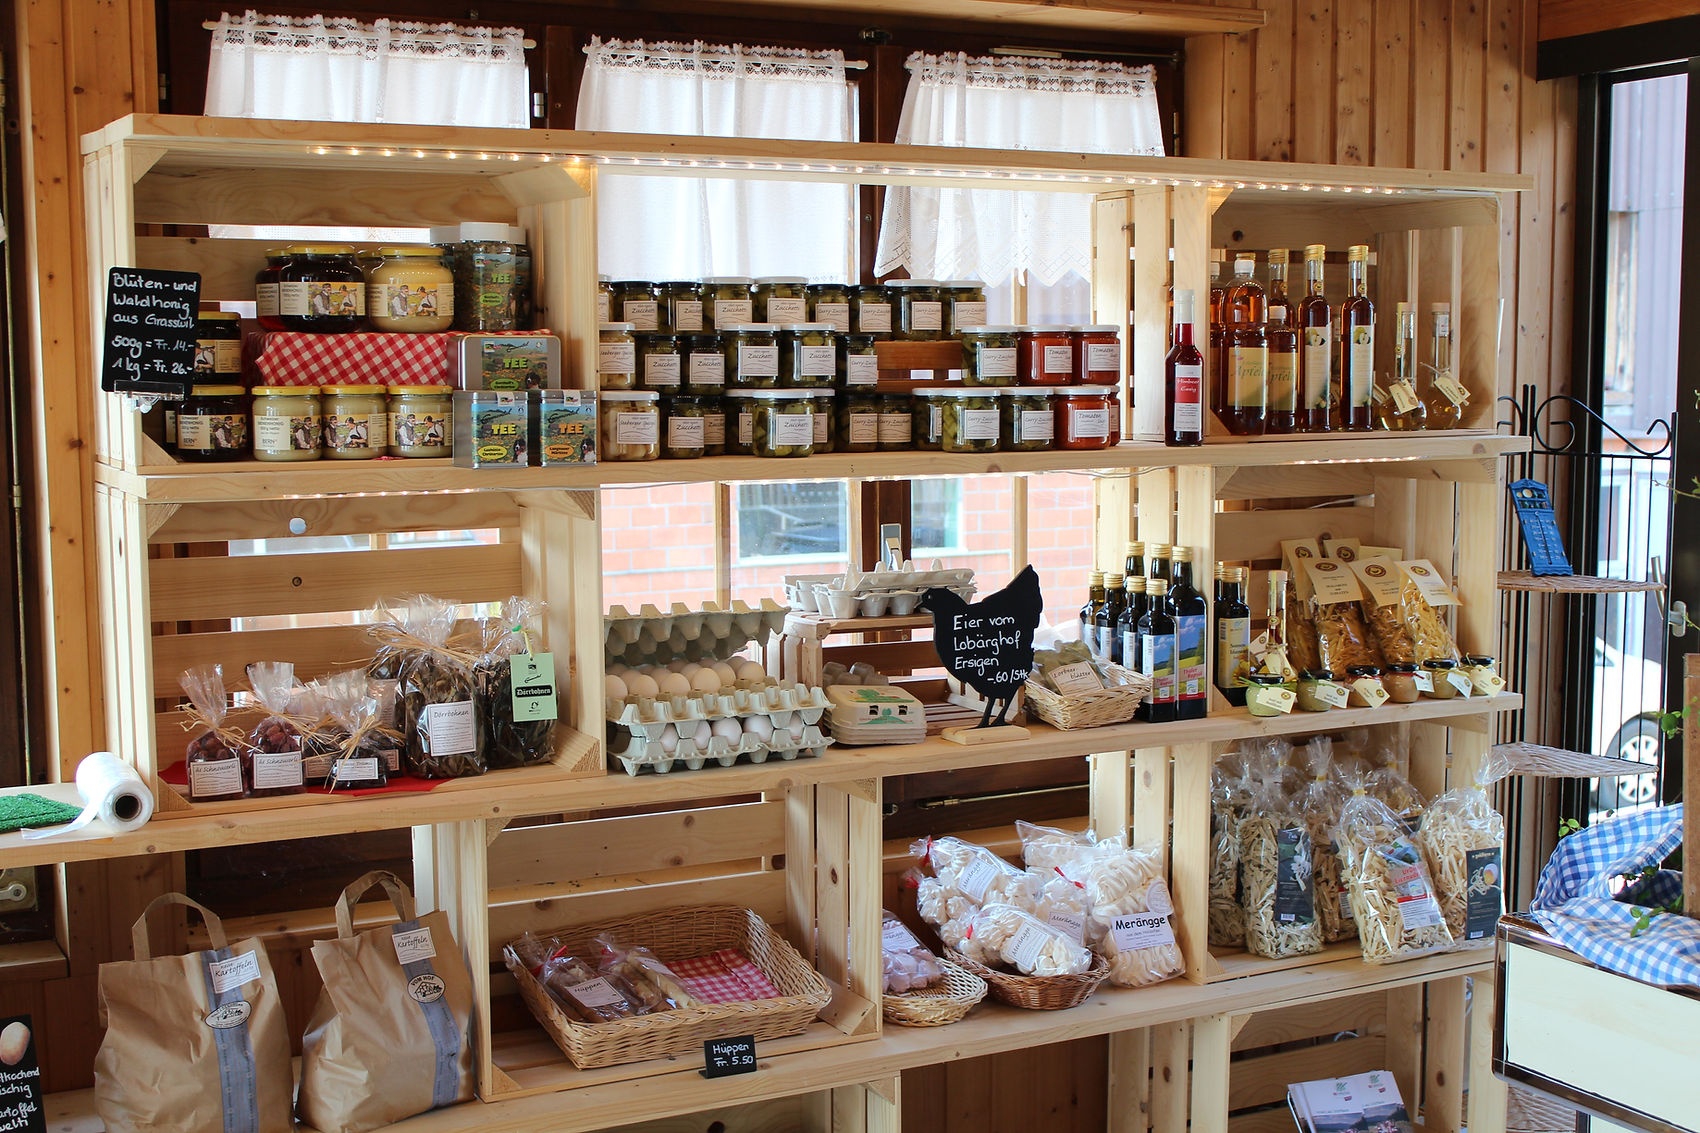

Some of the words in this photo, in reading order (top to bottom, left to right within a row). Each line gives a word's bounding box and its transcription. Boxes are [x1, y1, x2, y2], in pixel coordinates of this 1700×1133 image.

[490, 273, 511, 284] TEE
[173, 280, 197, 292] und
[112, 293, 190, 320] Waldhonig
[112, 313, 139, 324] aus
[144, 314, 194, 328] Grasswil
[112, 335, 143, 358] 500g
[154, 338, 170, 350] Fr.
[126, 357, 141, 382] kg
[153, 359, 168, 373] Fr.
[503, 358, 528, 369] TEE
[492, 424, 517, 435] TEE
[558, 424, 584, 435] TEE
[954, 614, 983, 630] Eier
[989, 616, 1015, 626] vom
[954, 630, 1020, 655] Lobärghof
[955, 654, 999, 676] Ersigen
[1115, 916, 1166, 930] Merängge
[397, 936, 428, 950] Kartoffeln
[215, 959, 253, 977] Kartoffeln
[713, 1043, 750, 1056] Hüppen
[714, 1057, 729, 1067] Fr.
[731, 1055, 754, 1066] 5.50
